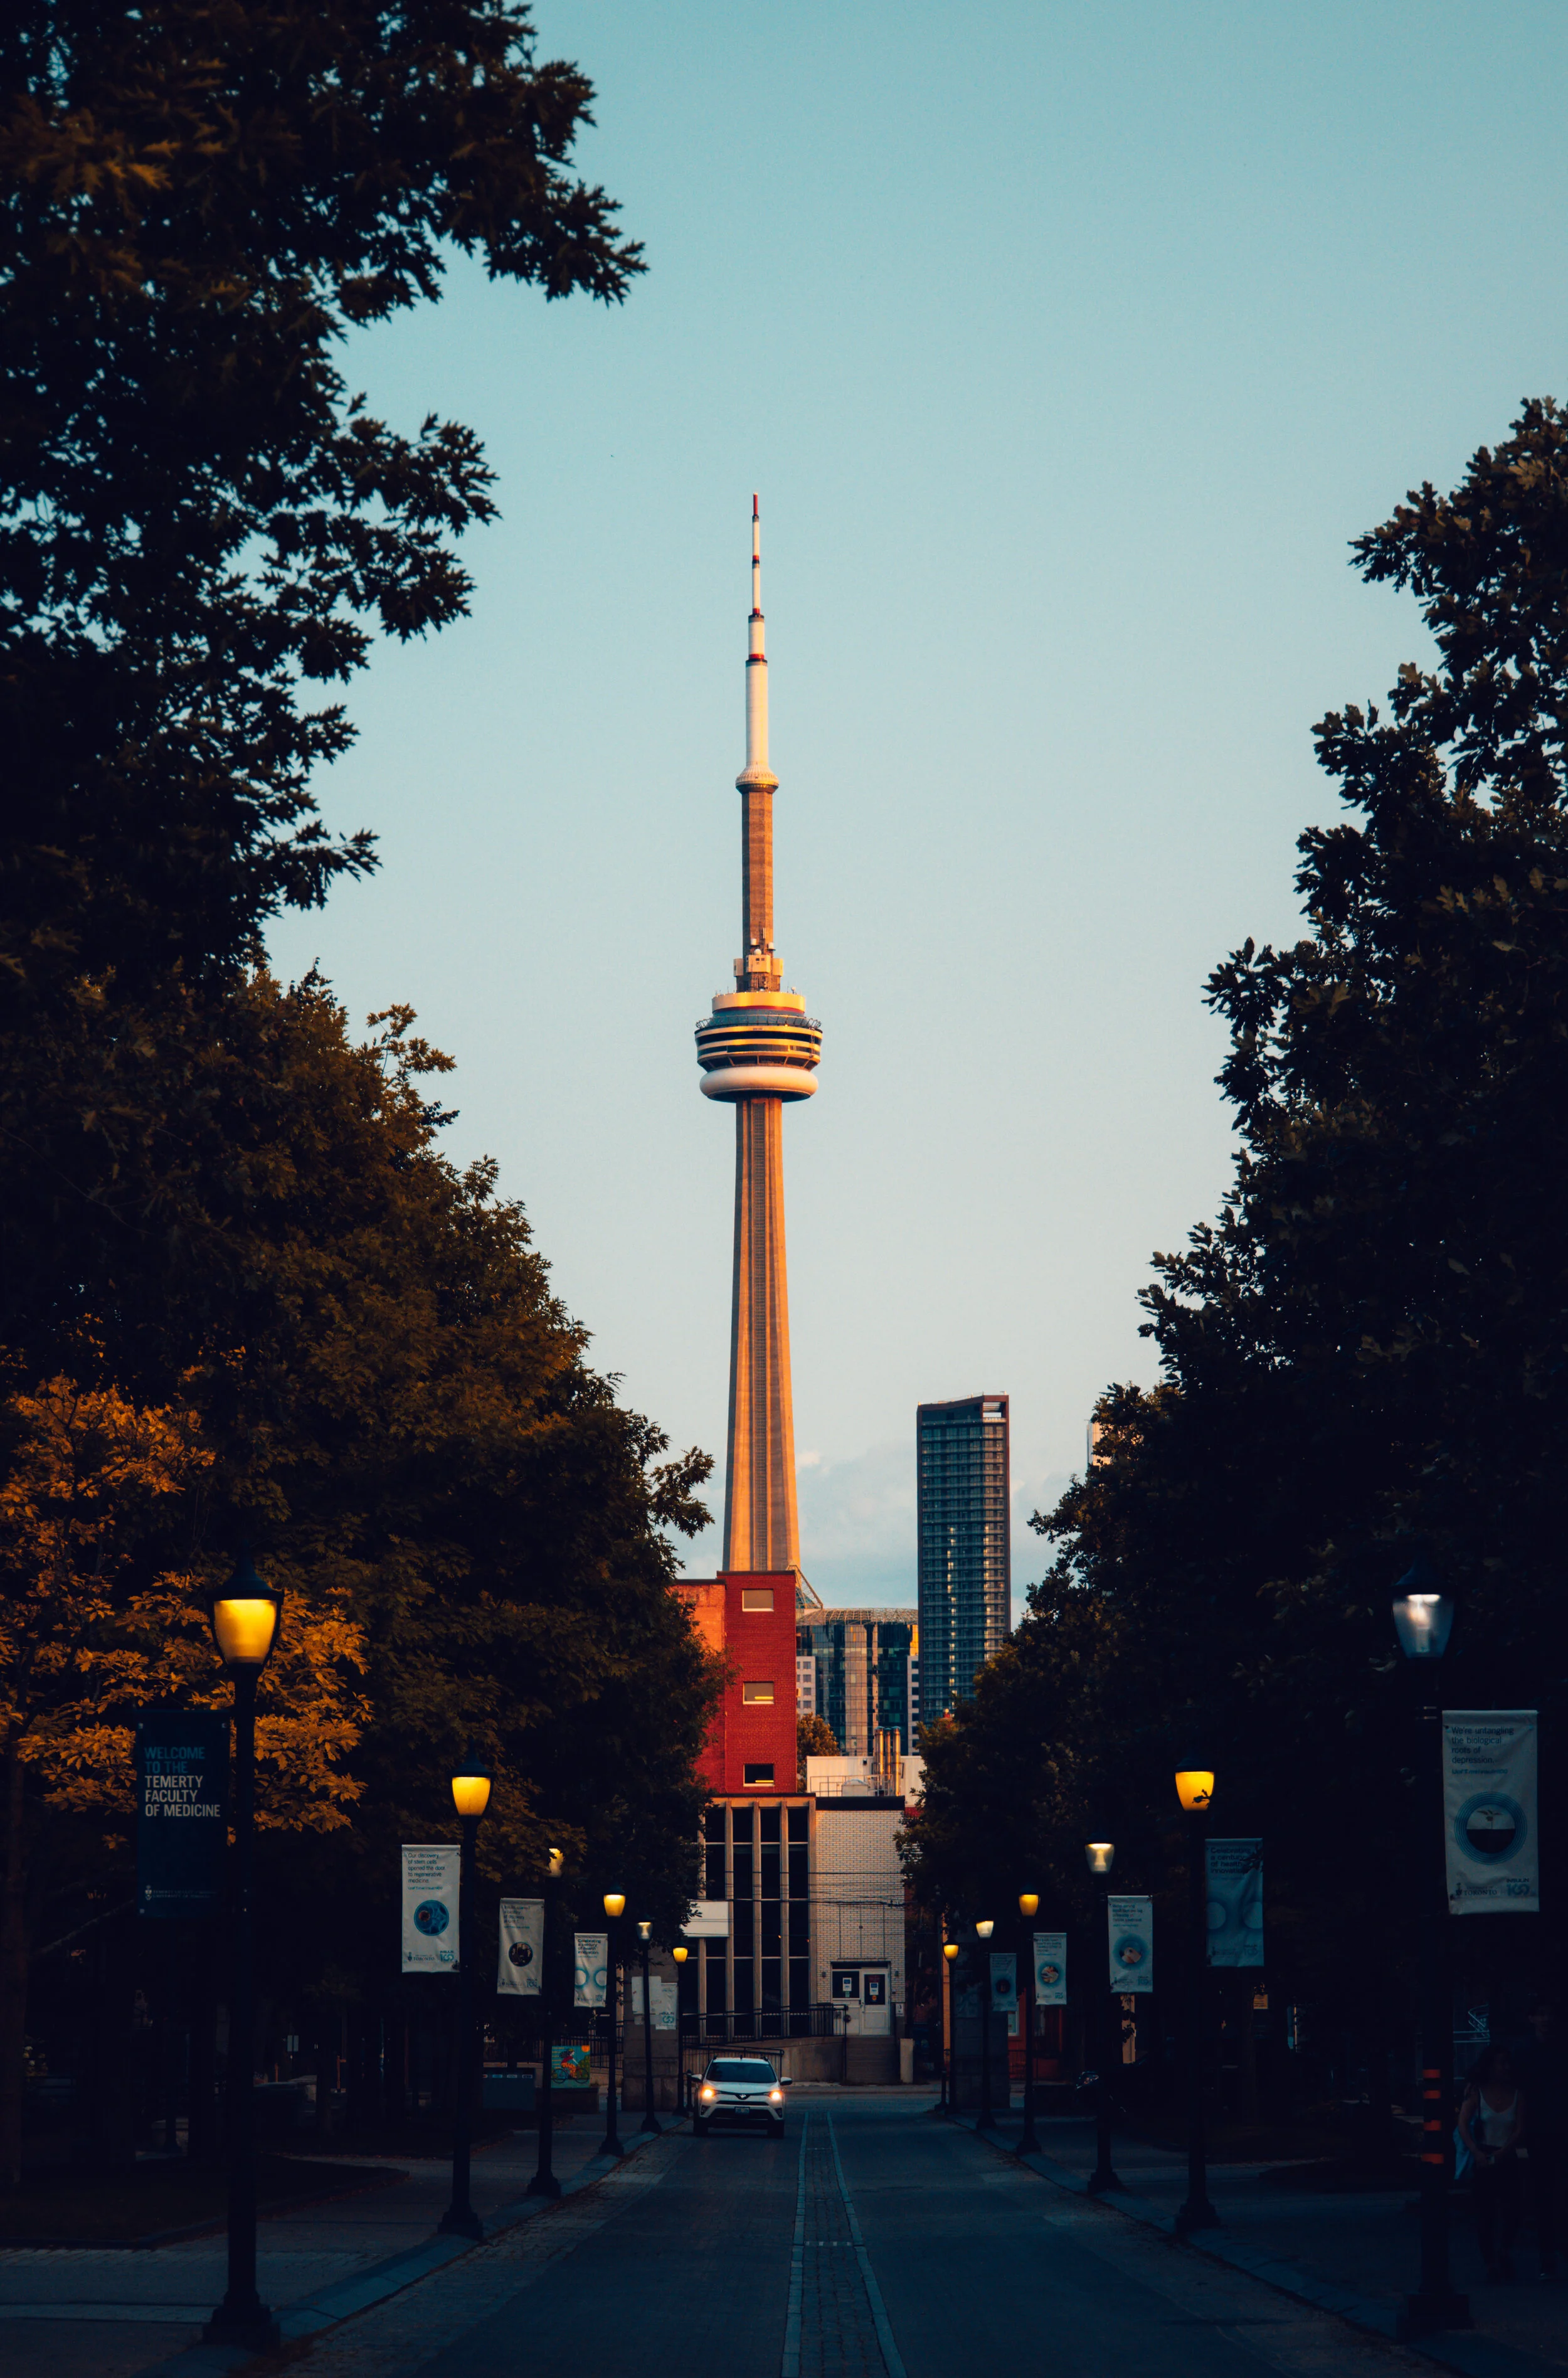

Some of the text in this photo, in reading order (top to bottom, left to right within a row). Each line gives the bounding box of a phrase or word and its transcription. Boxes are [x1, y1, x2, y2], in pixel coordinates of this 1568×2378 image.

[1452, 1726, 1514, 1736] We're untangling
[1467, 1736, 1502, 1745] biological
[144, 1746, 206, 1760] WELCOME
[1473, 1746, 1481, 1754] of
[1452, 1757, 1494, 1765] depression.
[144, 1761, 188, 1774] TO THE
[144, 1775, 204, 1788] TEMERTY
[145, 1790, 198, 1802] FACULTY
[145, 1804, 221, 1817] OF MEDICINE
